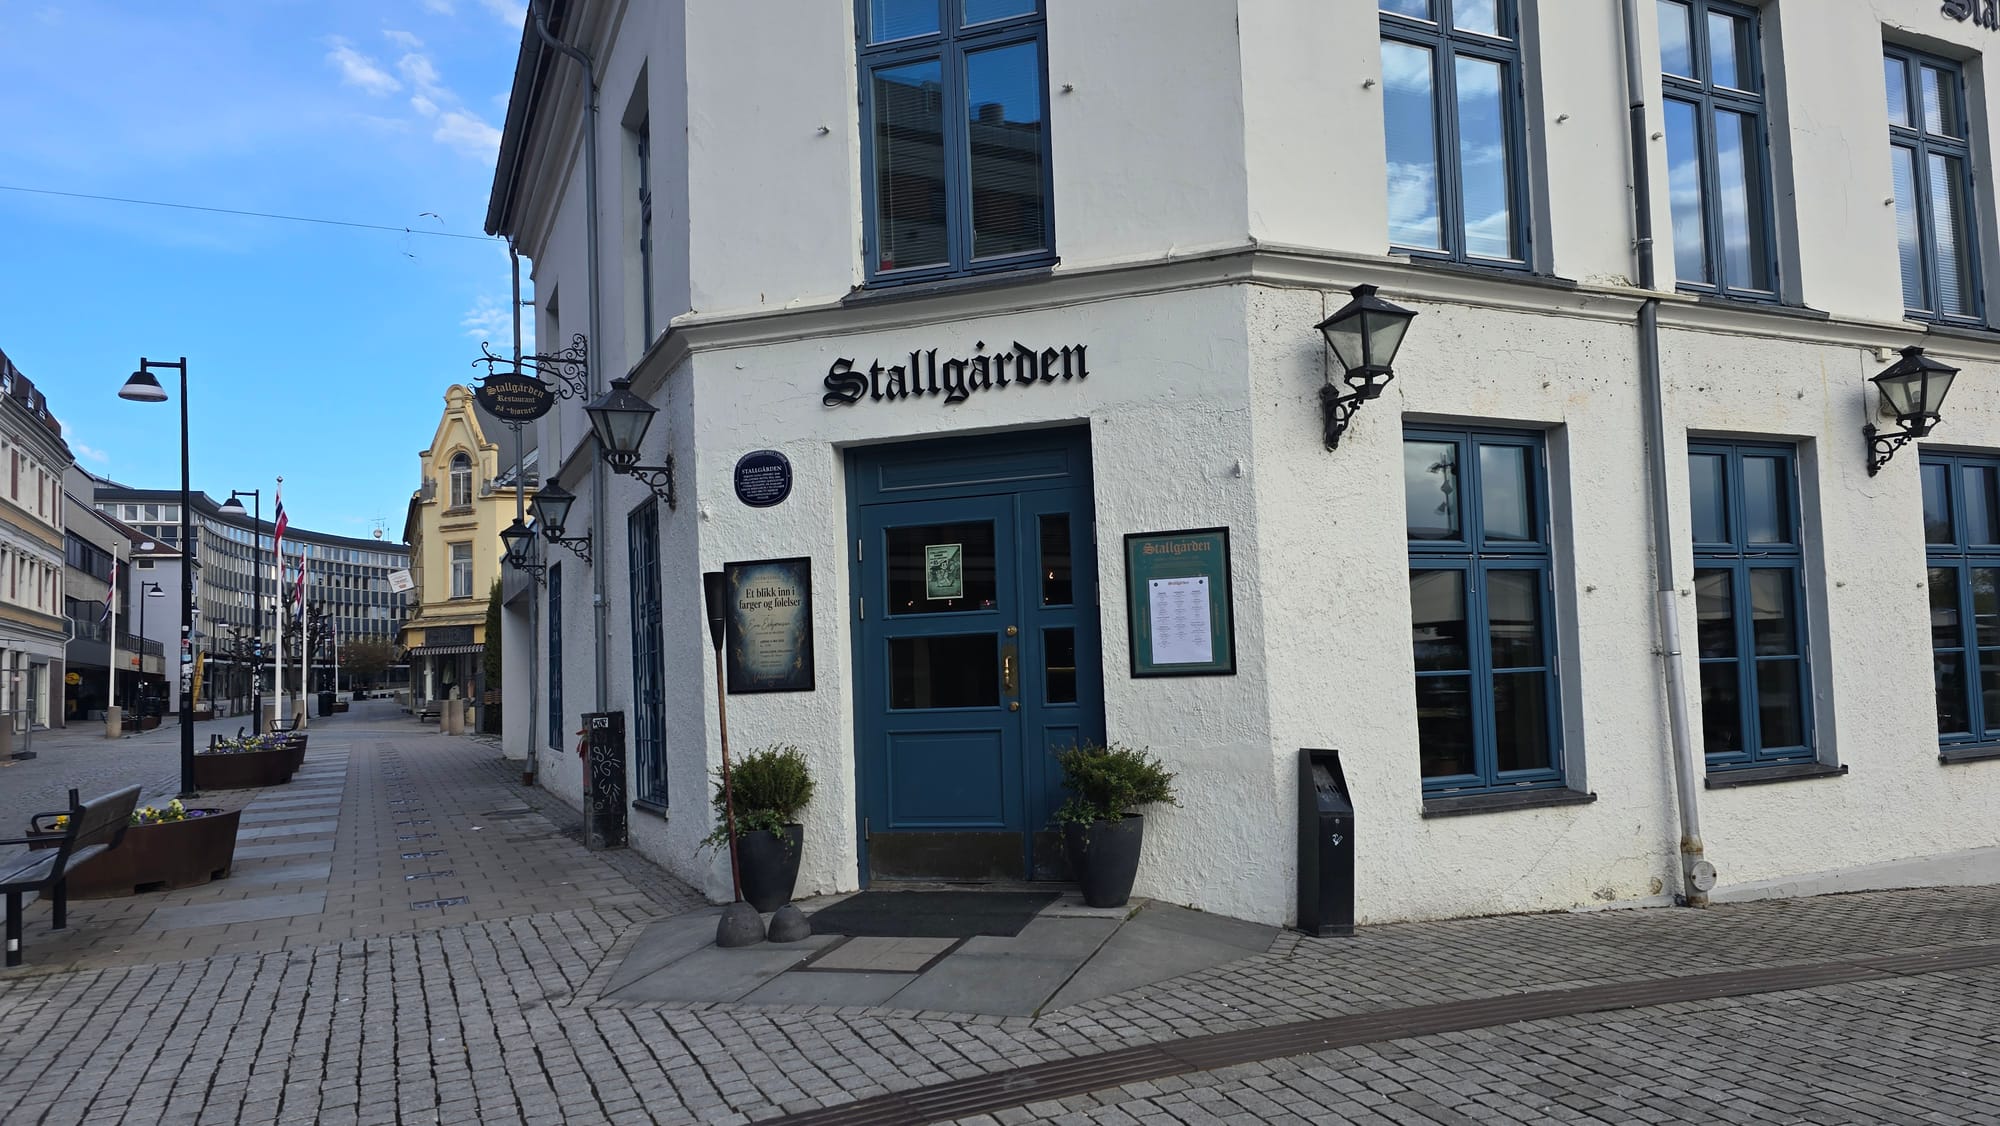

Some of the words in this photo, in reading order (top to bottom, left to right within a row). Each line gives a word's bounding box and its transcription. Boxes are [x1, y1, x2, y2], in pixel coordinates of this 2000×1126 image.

[823, 340, 1090, 407] Stallgården
[486, 382, 545, 398] Stallgården
[497, 395, 536, 403] Restaurant
[741, 465, 782, 474] STALLGÅRDEN
[1143, 540, 1211, 555] Stallgården
[746, 588, 755, 598] Et
[757, 587, 777, 598] blikk
[778, 586, 791, 597] inn
[739, 599, 761, 612] farger
[763, 601, 773, 611] og
